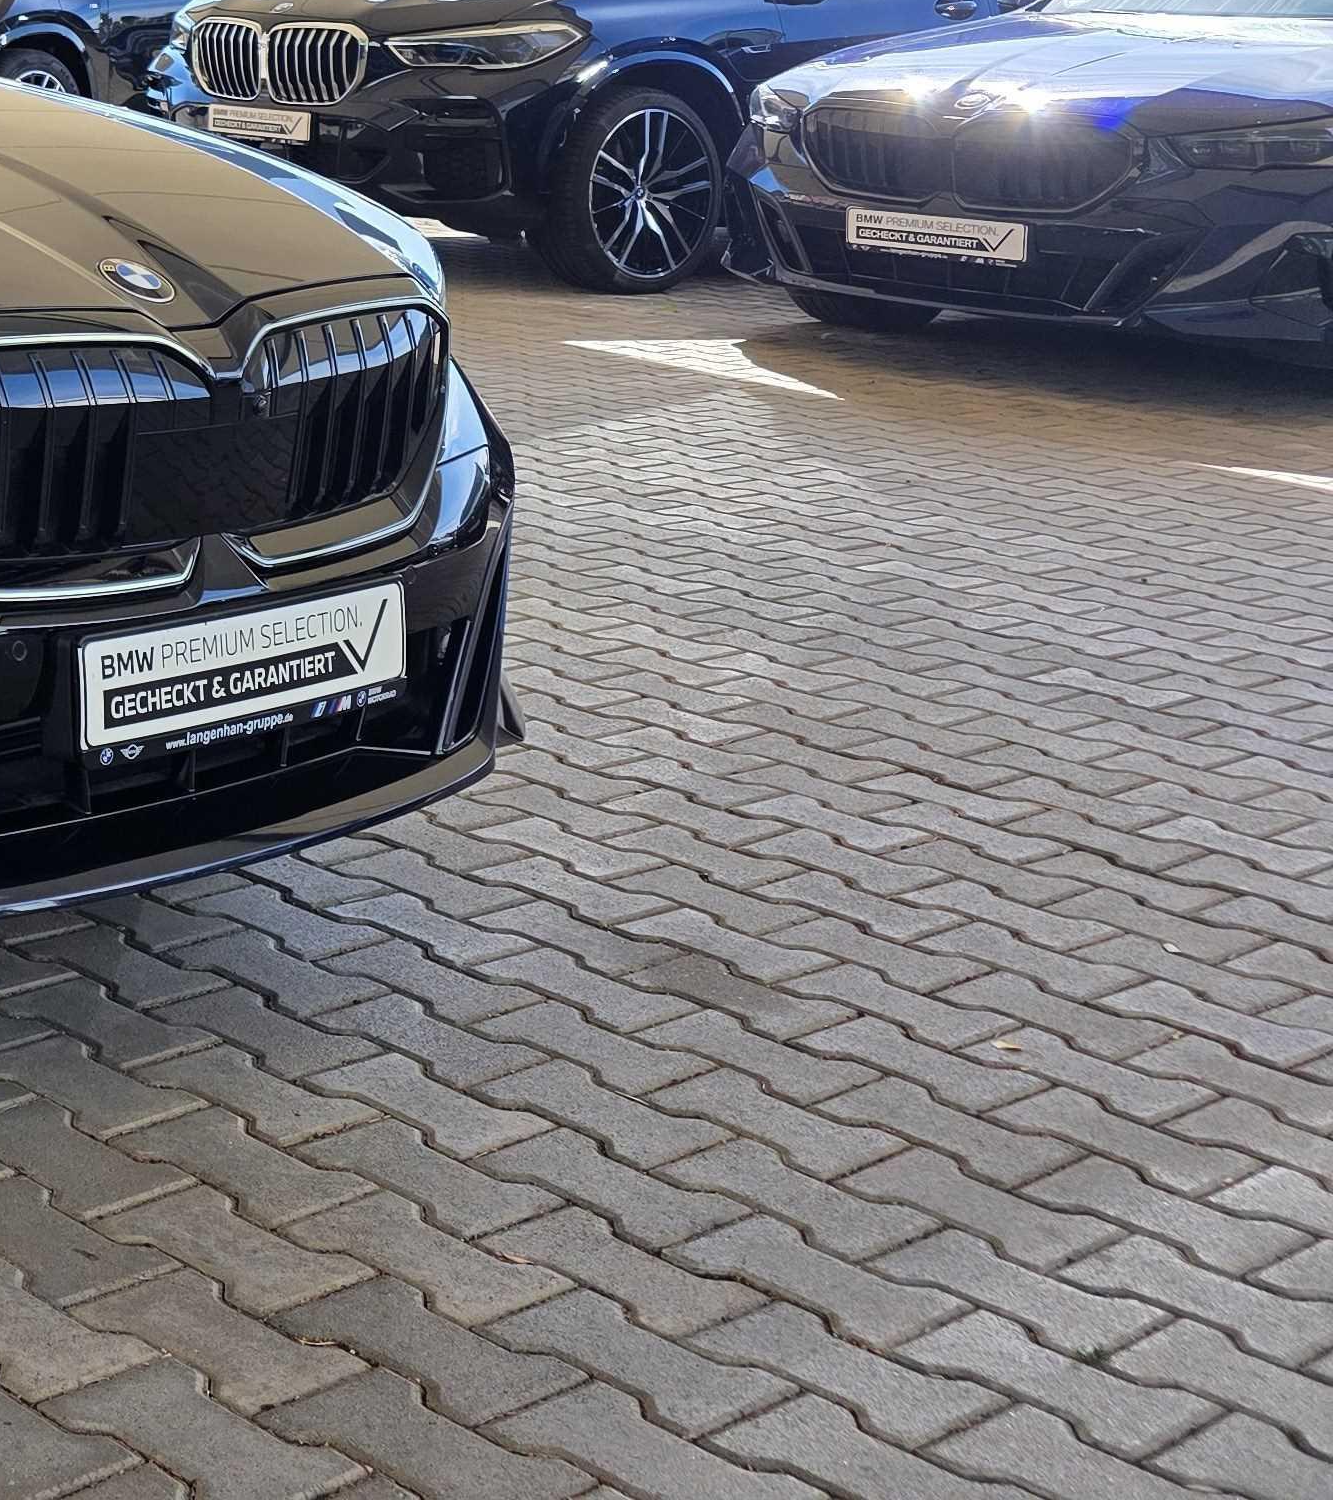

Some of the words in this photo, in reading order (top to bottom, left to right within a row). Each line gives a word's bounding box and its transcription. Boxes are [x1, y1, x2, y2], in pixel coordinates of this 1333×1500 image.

[856, 213, 884, 224] BMW
[885, 216, 934, 229] PREMIUM
[858, 228, 908, 241] GECHECKT
[908, 233, 915, 242] &
[916, 234, 979, 249] GARANTIERT
[100, 646, 155, 680] BMW
[161, 626, 255, 669] PREMIUM
[260, 603, 363, 649] SELECTION.
[110, 678, 208, 720] GECHECKT
[212, 676, 227, 699] &
[229, 651, 336, 695] GARANTIERT
[165, 712, 294, 751] www.langenhan-gruppe.de
